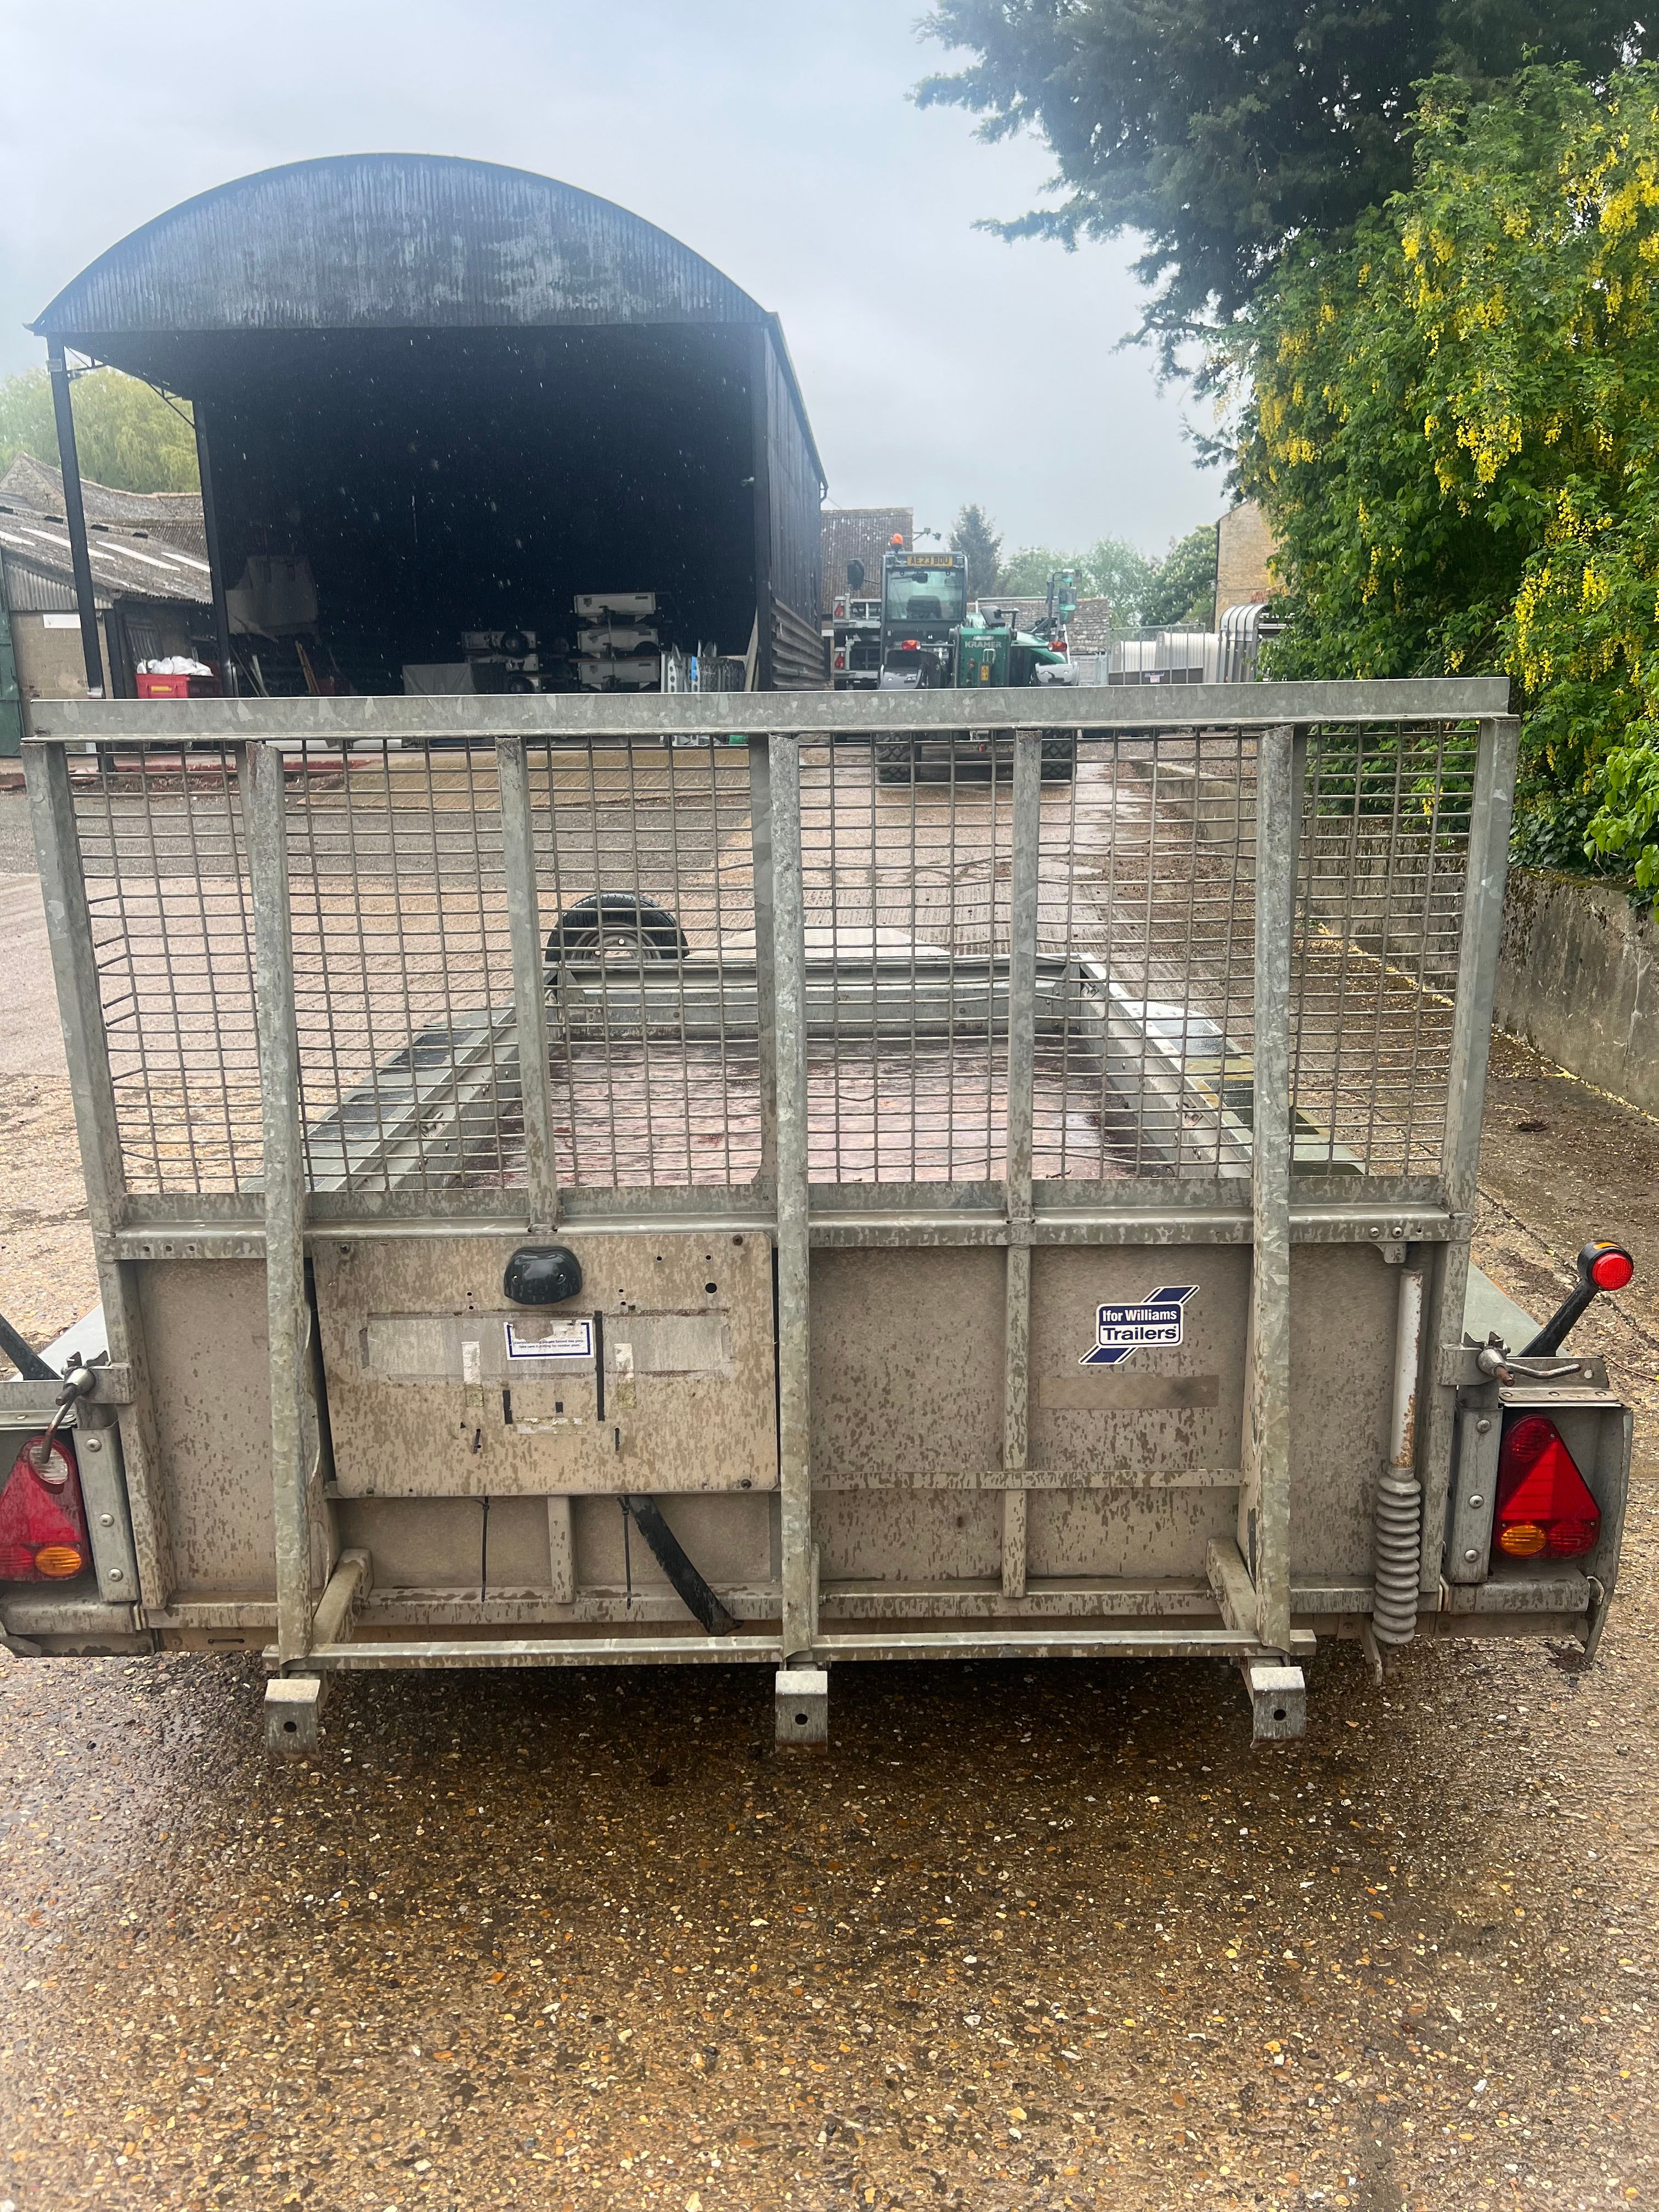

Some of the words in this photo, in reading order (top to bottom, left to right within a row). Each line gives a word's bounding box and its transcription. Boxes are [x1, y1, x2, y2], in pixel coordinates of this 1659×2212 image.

[911, 556, 931, 565] AE23
[934, 556, 949, 565] BDU
[1102, 1310, 1123, 1322] Ifor
[1125, 1309, 1177, 1321] Williams
[1103, 1327, 1177, 1340] Trailers
